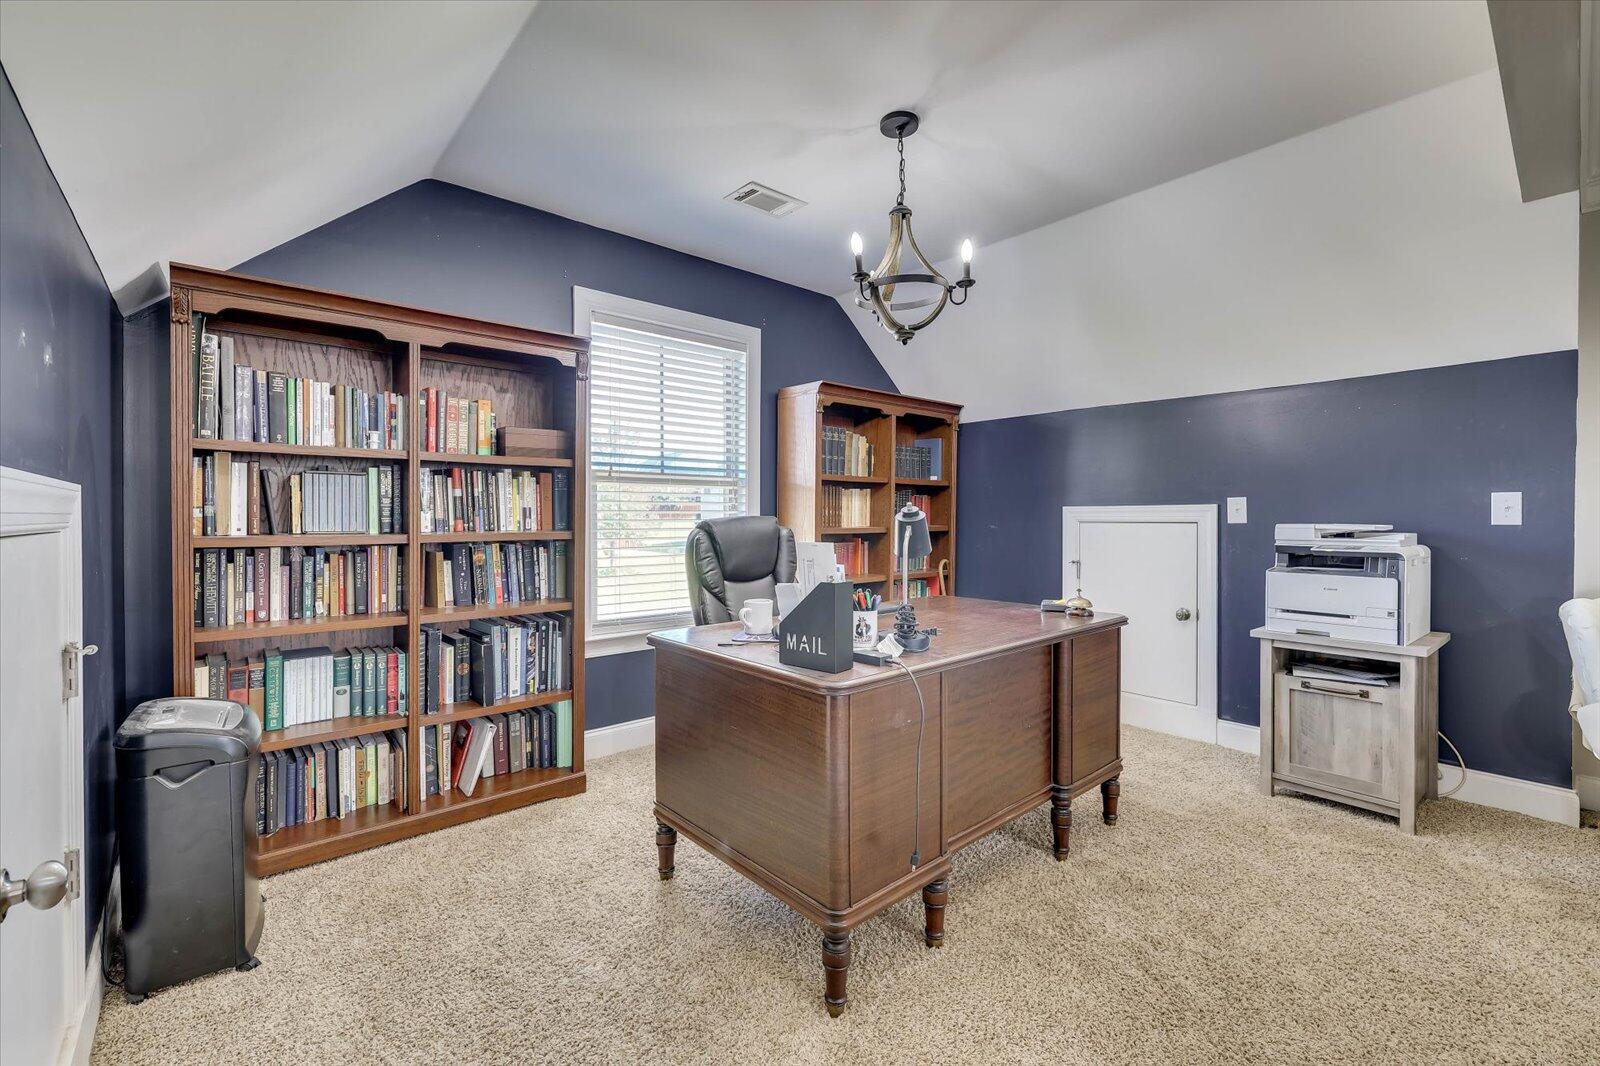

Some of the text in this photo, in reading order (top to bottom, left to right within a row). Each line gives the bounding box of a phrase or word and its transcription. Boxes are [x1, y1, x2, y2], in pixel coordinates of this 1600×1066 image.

[201, 354, 215, 402] BATTLE
[475, 568, 483, 594] NARNIA
[206, 586, 217, 614] HEWITT
[786, 632, 827, 656] MAIL
